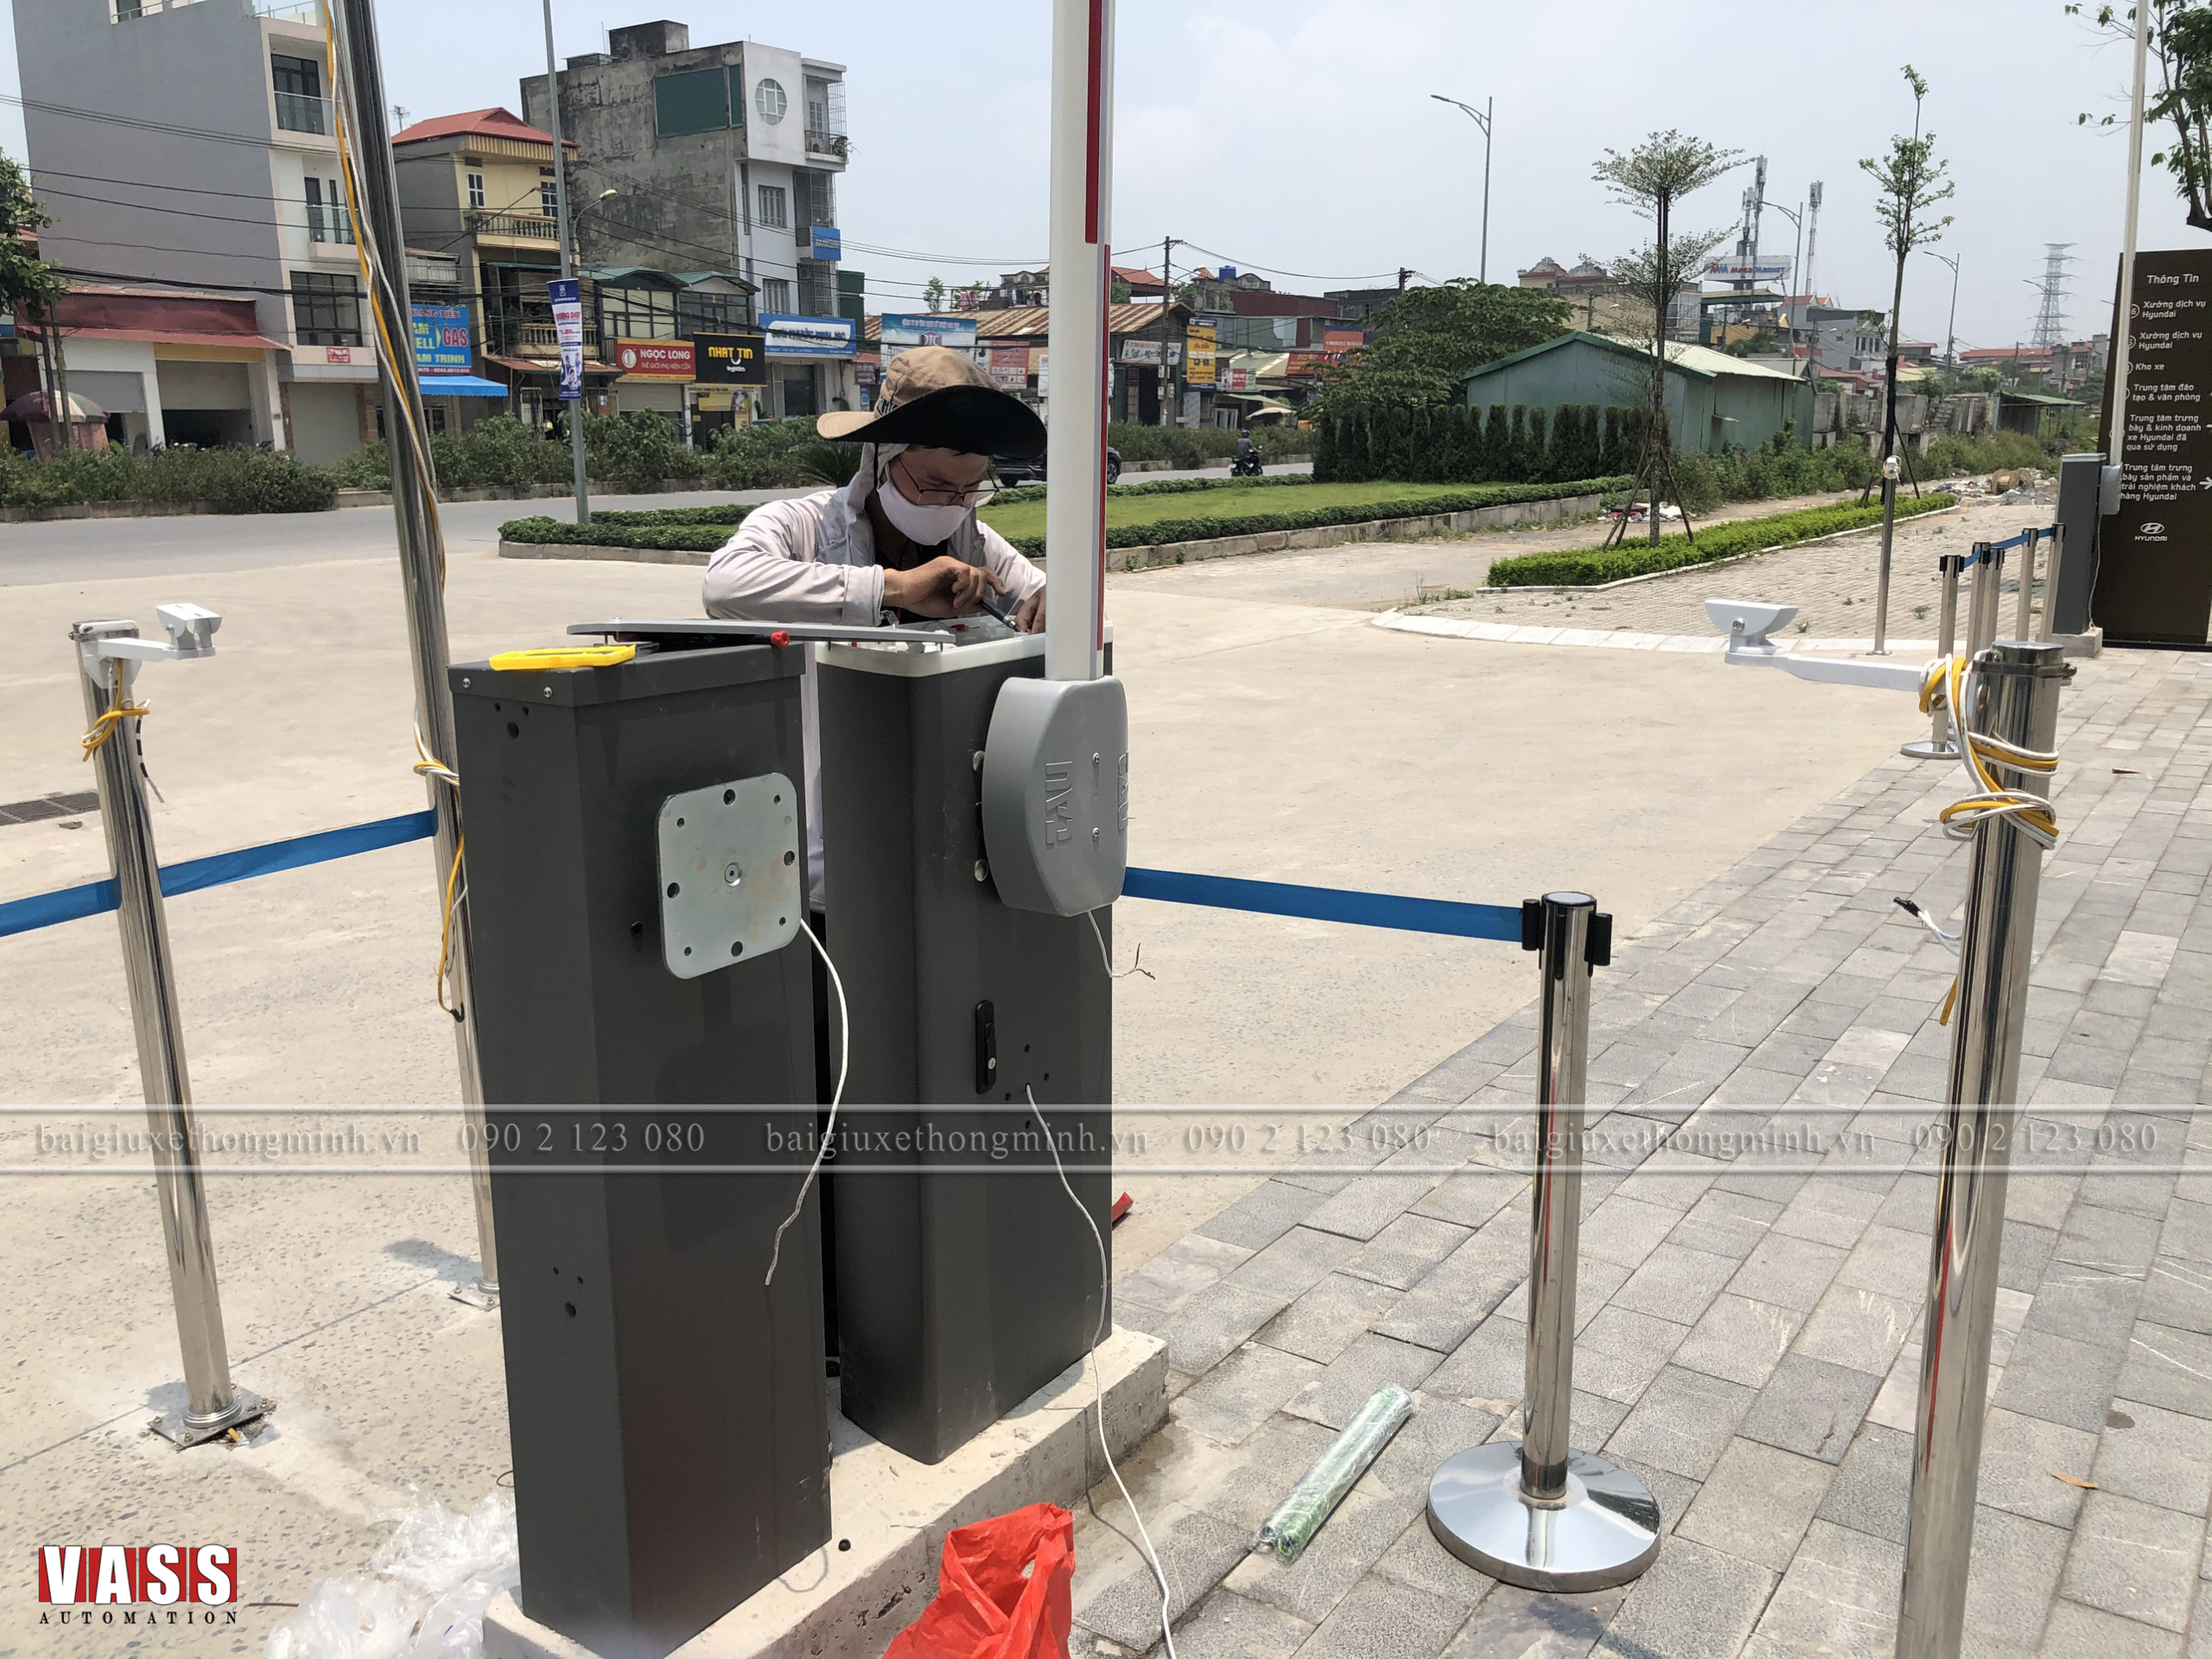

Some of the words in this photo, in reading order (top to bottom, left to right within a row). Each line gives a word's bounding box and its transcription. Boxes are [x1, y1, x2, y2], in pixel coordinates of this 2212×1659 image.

[2147, 275, 2179, 285] Thông
[2183, 274, 2199, 283] Tin
[2144, 301, 2173, 309] Xưởng
[2176, 300, 2193, 308] dịch
[2143, 310, 2177, 320] Hyundai
[442, 327, 468, 346] GAS
[2139, 332, 2170, 340] Xưởng
[2172, 331, 2190, 340] dịch
[2139, 341, 2173, 351] Hyundai
[640, 349, 666, 361] NGỌC
[668, 350, 690, 359] LONG
[2134, 384, 2158, 393] Trung
[2174, 393, 2201, 403] phòng
[2130, 414, 2154, 423] Trung
[2175, 415, 2199, 423] trưng
[2128, 423, 2144, 432] bày
[2139, 434, 2174, 442] Hyundai
[2124, 463, 2148, 473] Trung
[2168, 464, 2193, 473] trưng
[2156, 473, 2179, 481] phẩm
[2138, 483, 2168, 492] nghiệm
[2143, 493, 2177, 501] Hyundai
